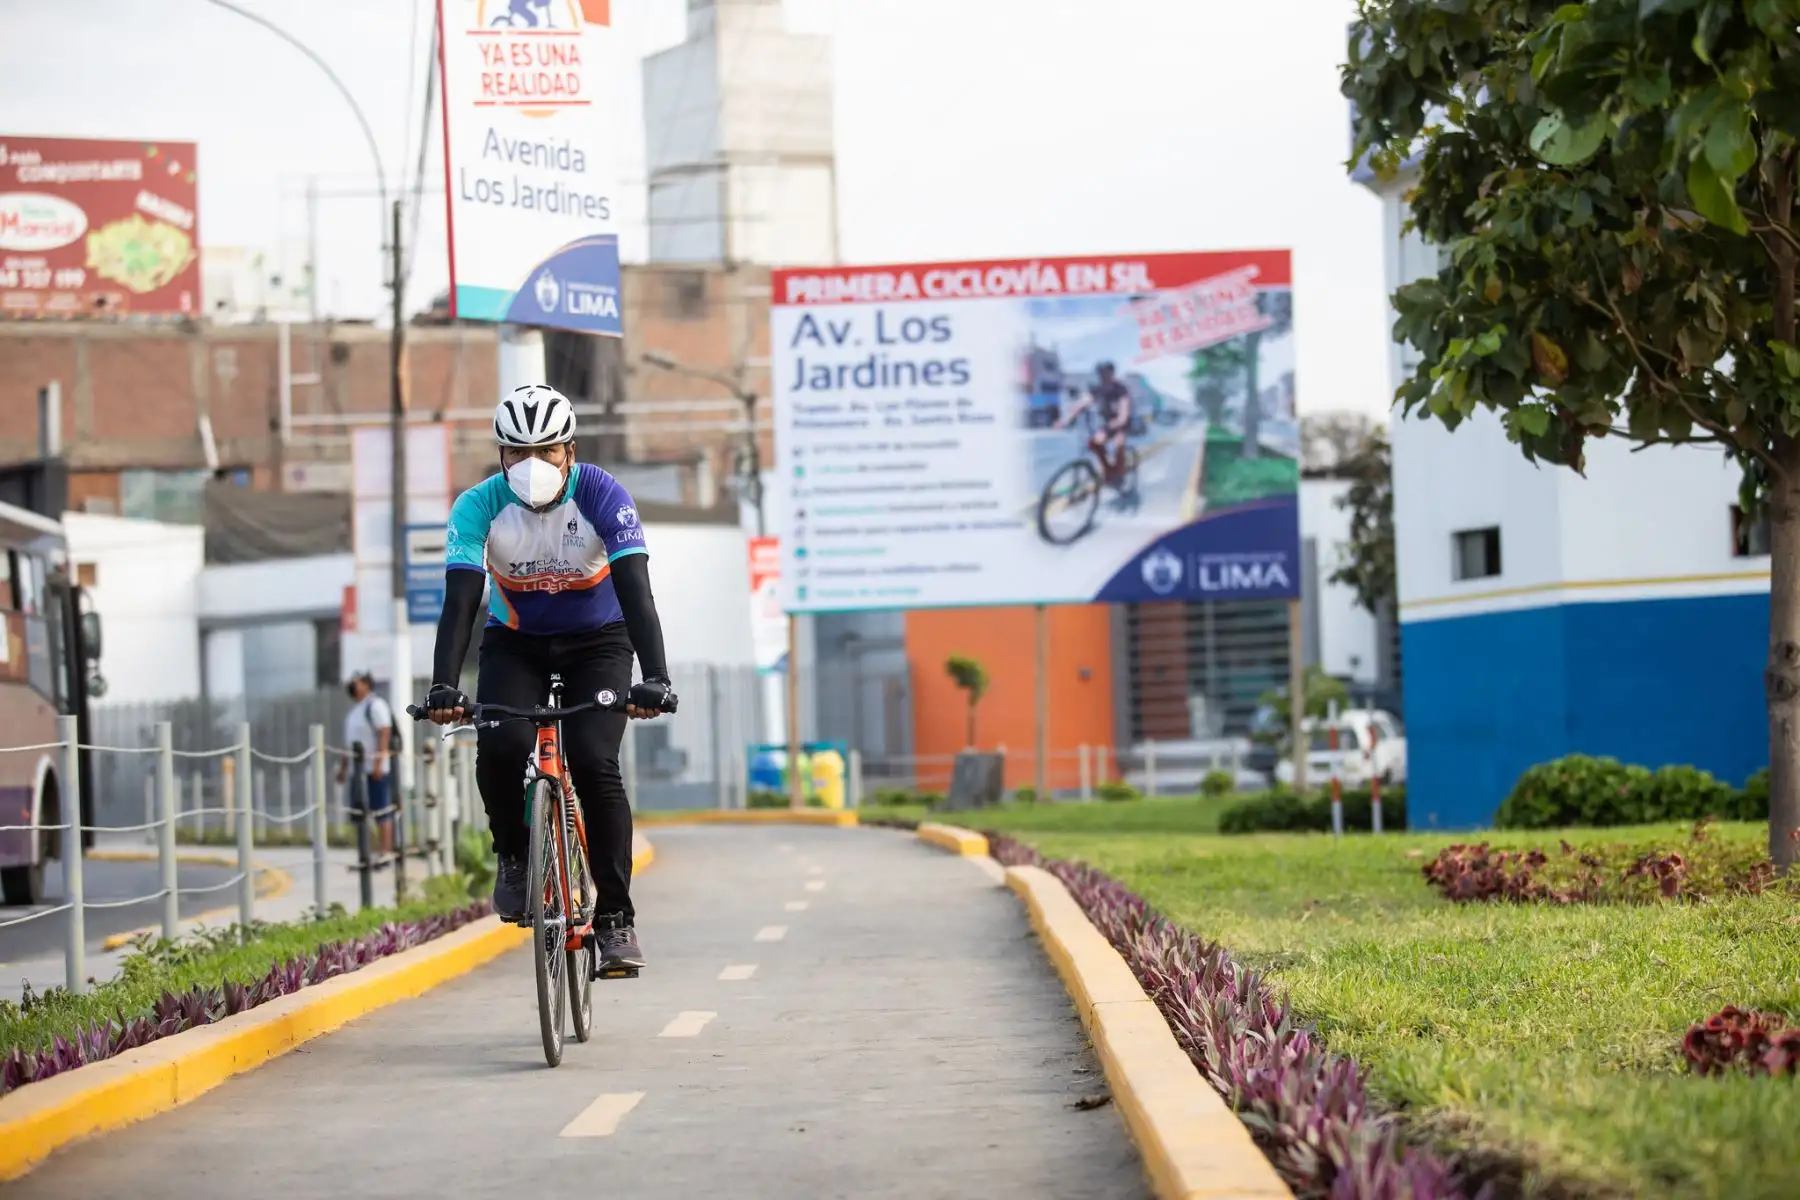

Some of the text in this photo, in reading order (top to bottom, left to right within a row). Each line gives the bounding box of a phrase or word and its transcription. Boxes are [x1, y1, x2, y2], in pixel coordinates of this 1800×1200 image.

[479, 43, 581, 66] YA ES UNA
[481, 72, 581, 96] REALIDAD
[483, 127, 586, 173] Avenida
[460, 167, 610, 220] Los Jardines
[786, 271, 919, 303] PRIMERA
[921, 259, 1061, 297] CICLOVÍA
[1065, 264, 1105, 292] EN
[567, 291, 618, 318] LIMA
[790, 309, 953, 347] Av. Los
[790, 353, 970, 392] Jardines
[617, 529, 644, 543] LIMA
[1200, 562, 1290, 591] LIMA
